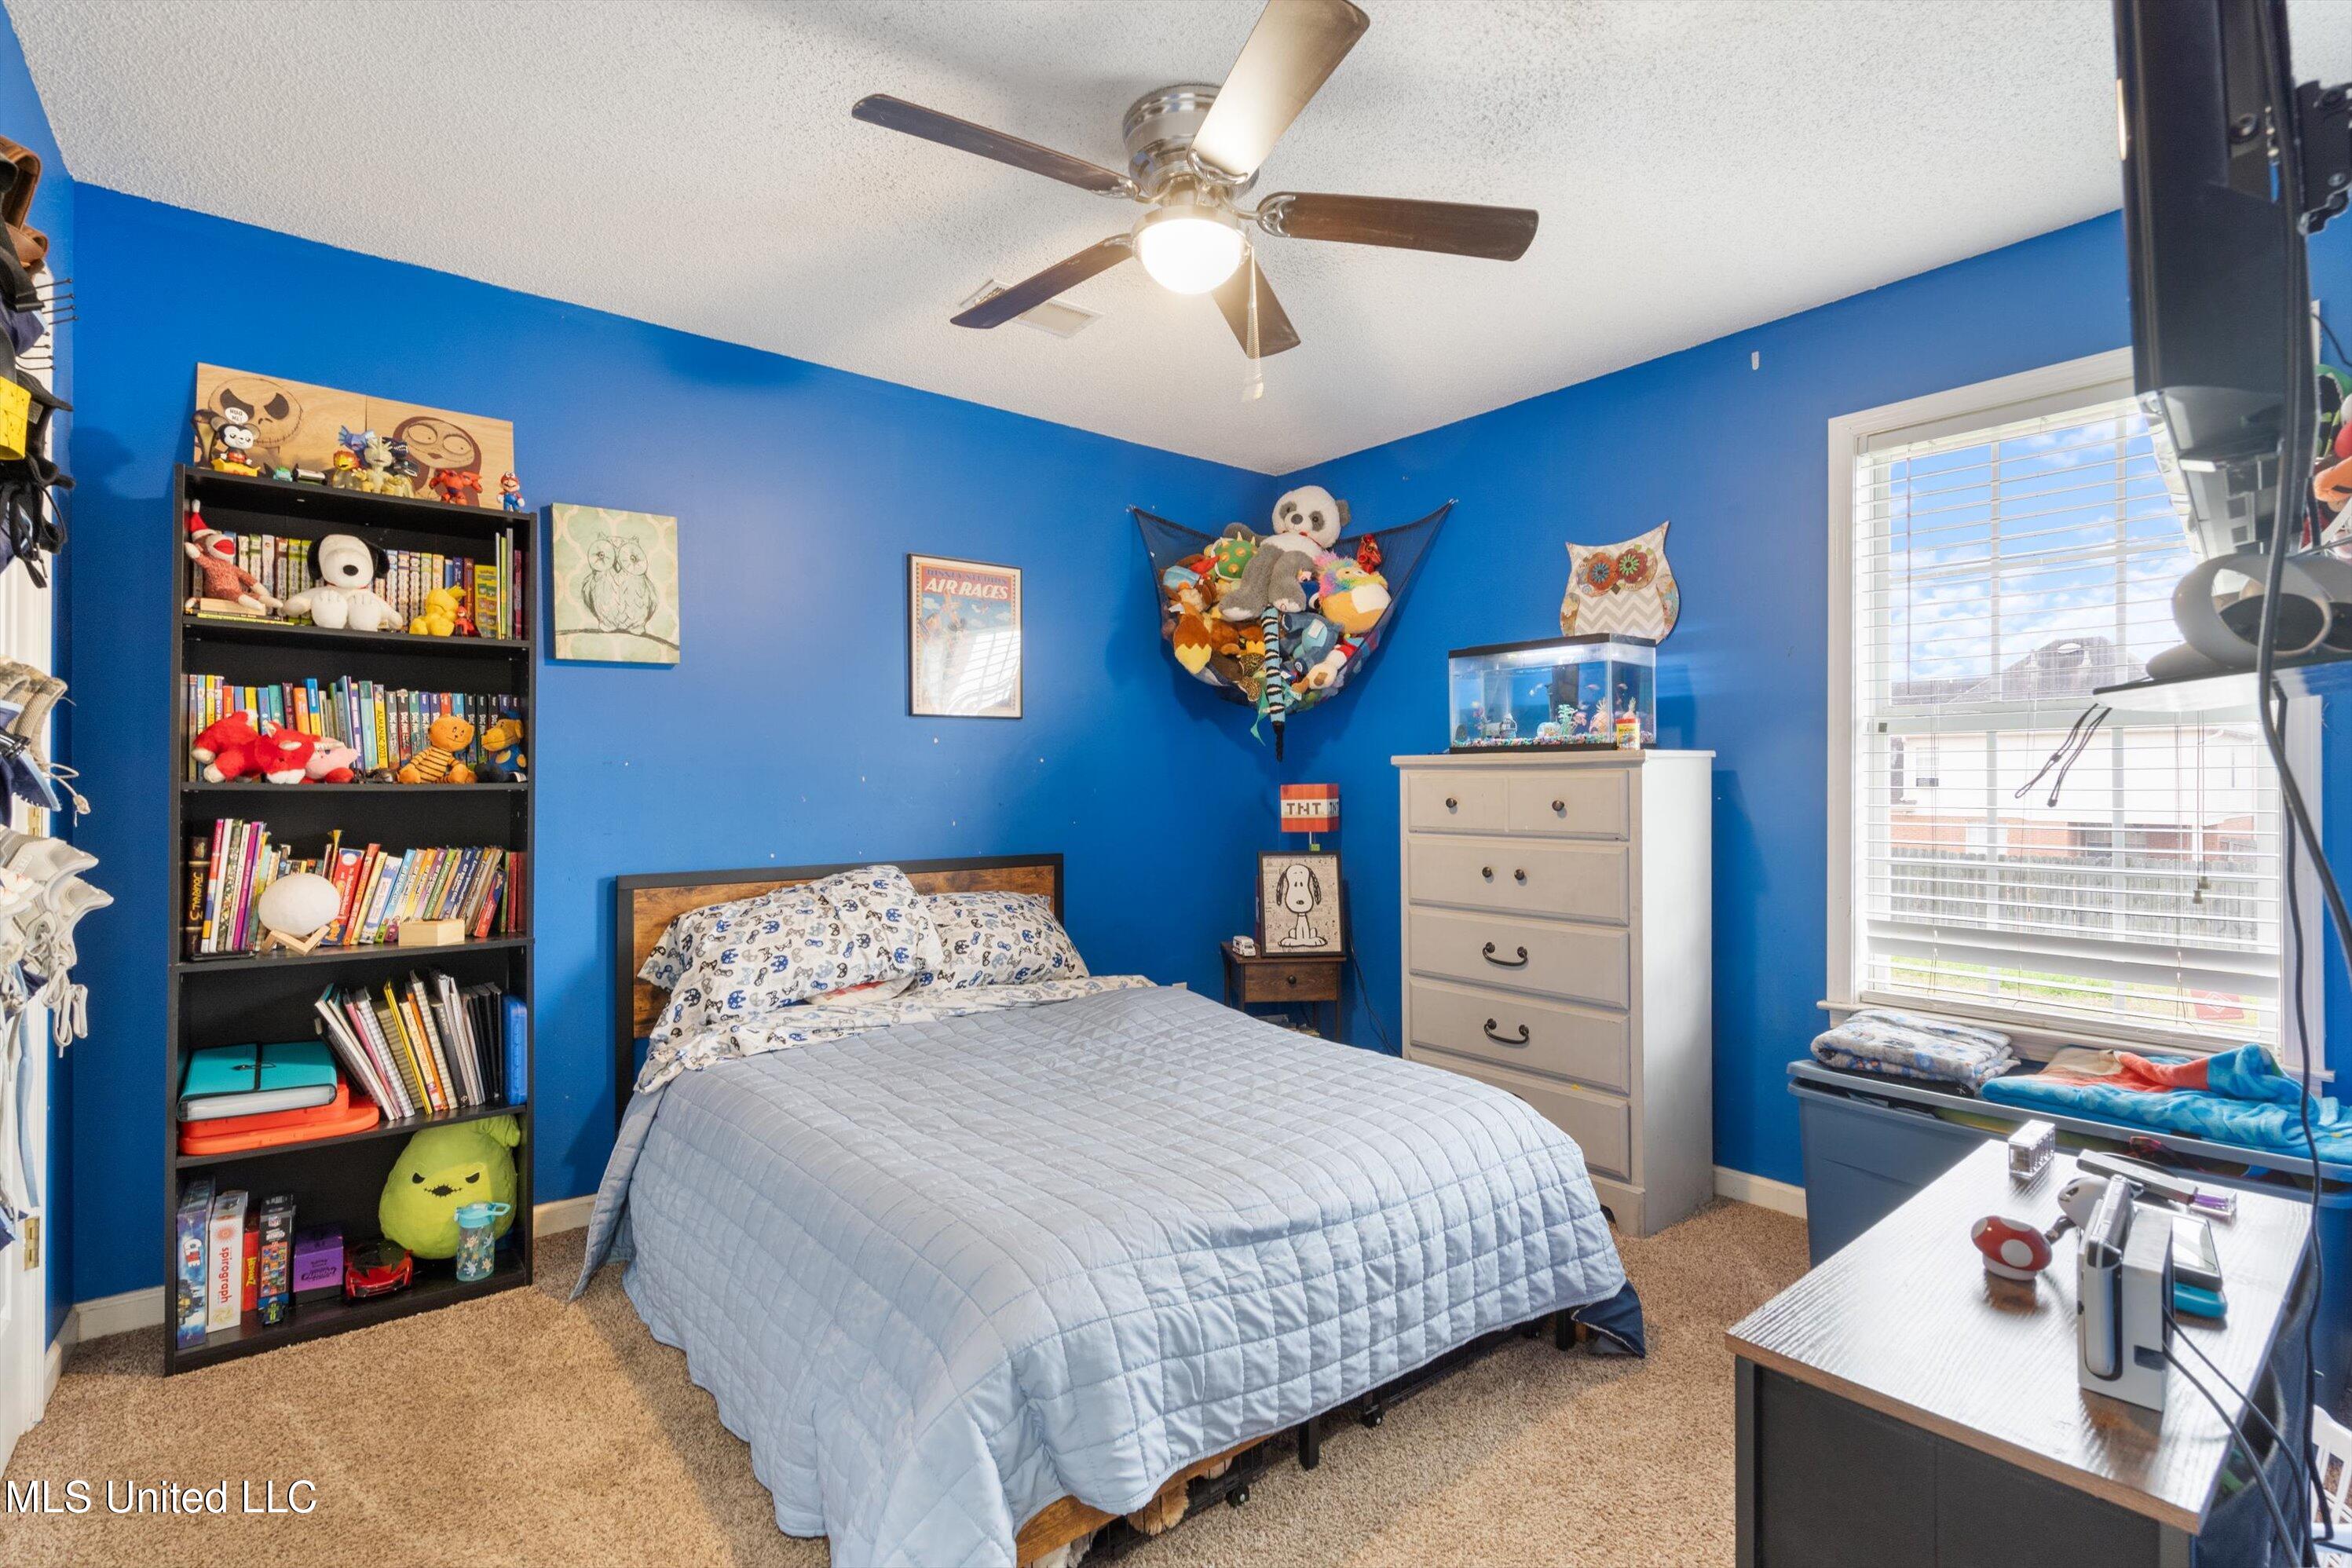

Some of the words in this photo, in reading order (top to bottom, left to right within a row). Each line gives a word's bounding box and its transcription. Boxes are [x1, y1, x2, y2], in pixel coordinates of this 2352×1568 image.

[925, 578, 958, 594] AIR
[959, 582, 1008, 599] RACES
[1287, 802, 1321, 815] TNT
[191, 872, 203, 910] JOURNAL
[189, 909, 203, 921] 3
[218, 1247, 232, 1303] spirograph
